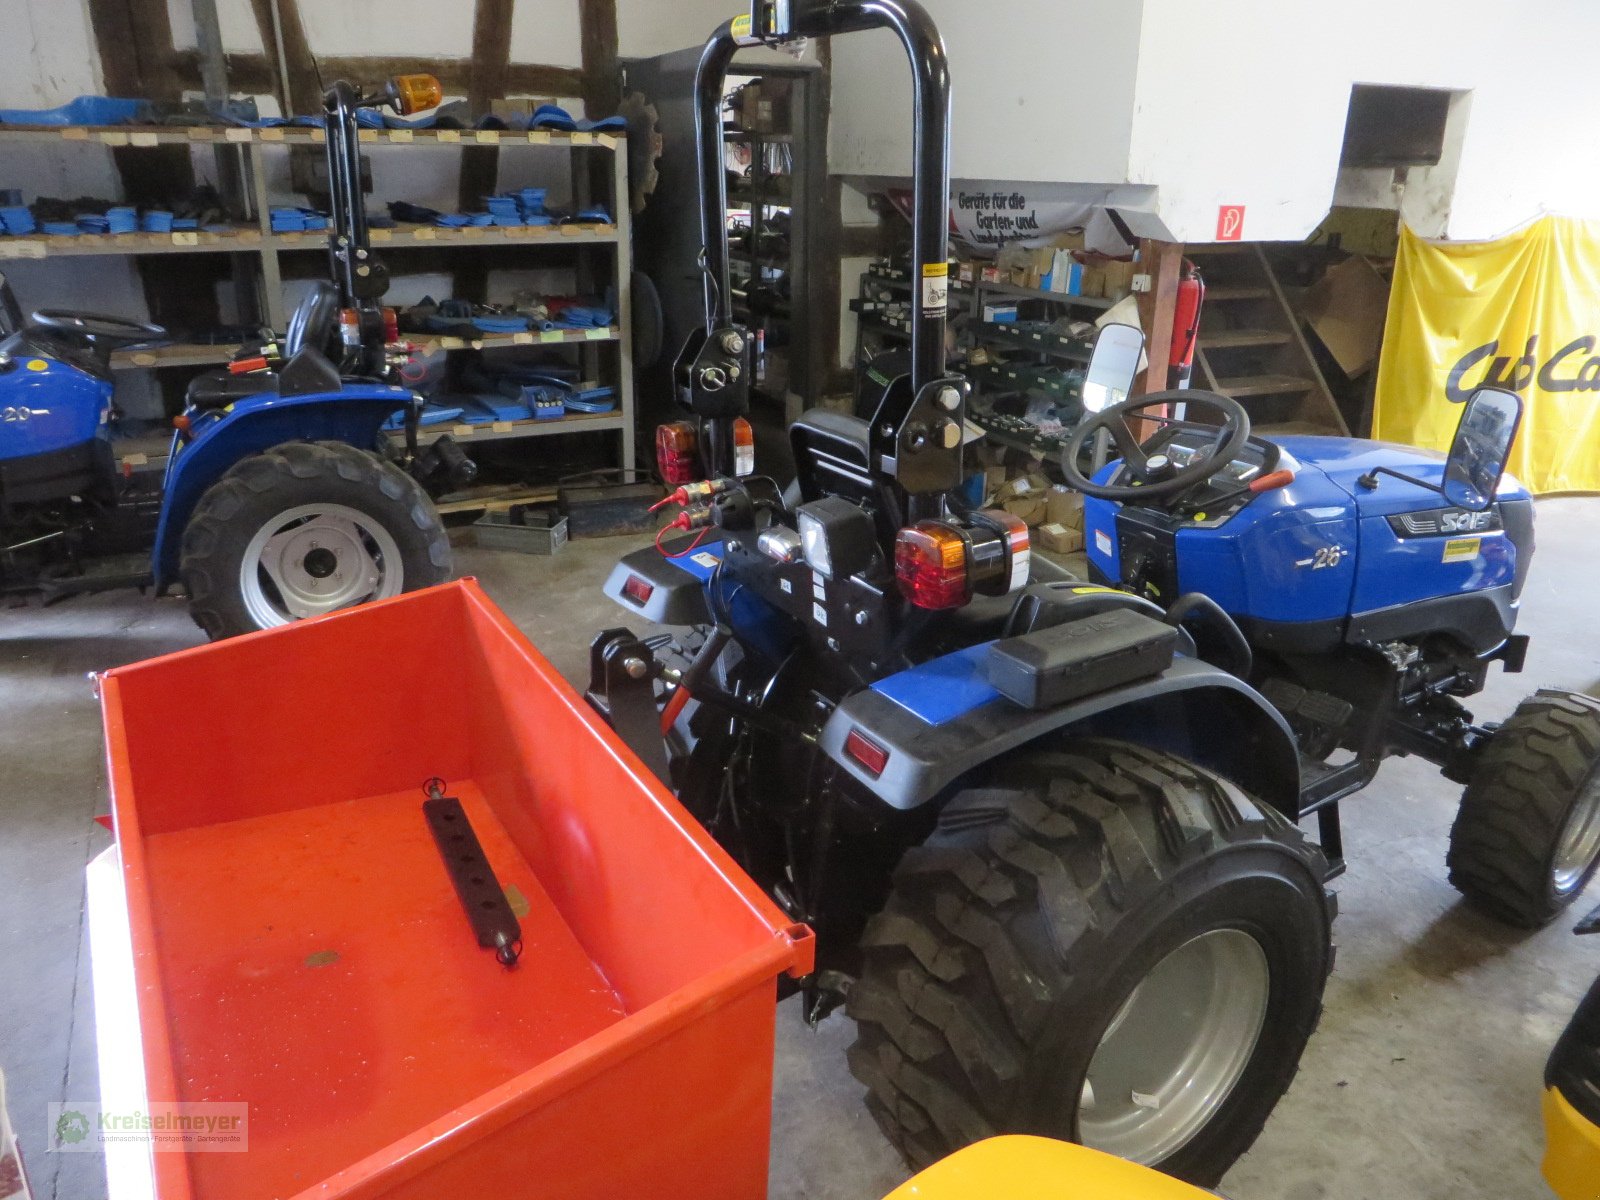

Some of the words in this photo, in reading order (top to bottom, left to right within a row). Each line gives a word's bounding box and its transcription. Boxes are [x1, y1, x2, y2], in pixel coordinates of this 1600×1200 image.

[958, 192, 991, 210] Geräte
[992, 192, 1008, 210] für
[1008, 192, 1025, 210] die
[976, 210, 1014, 230] Garten-
[1015, 209, 1039, 229] und
[1445, 334, 1538, 403] Cub
